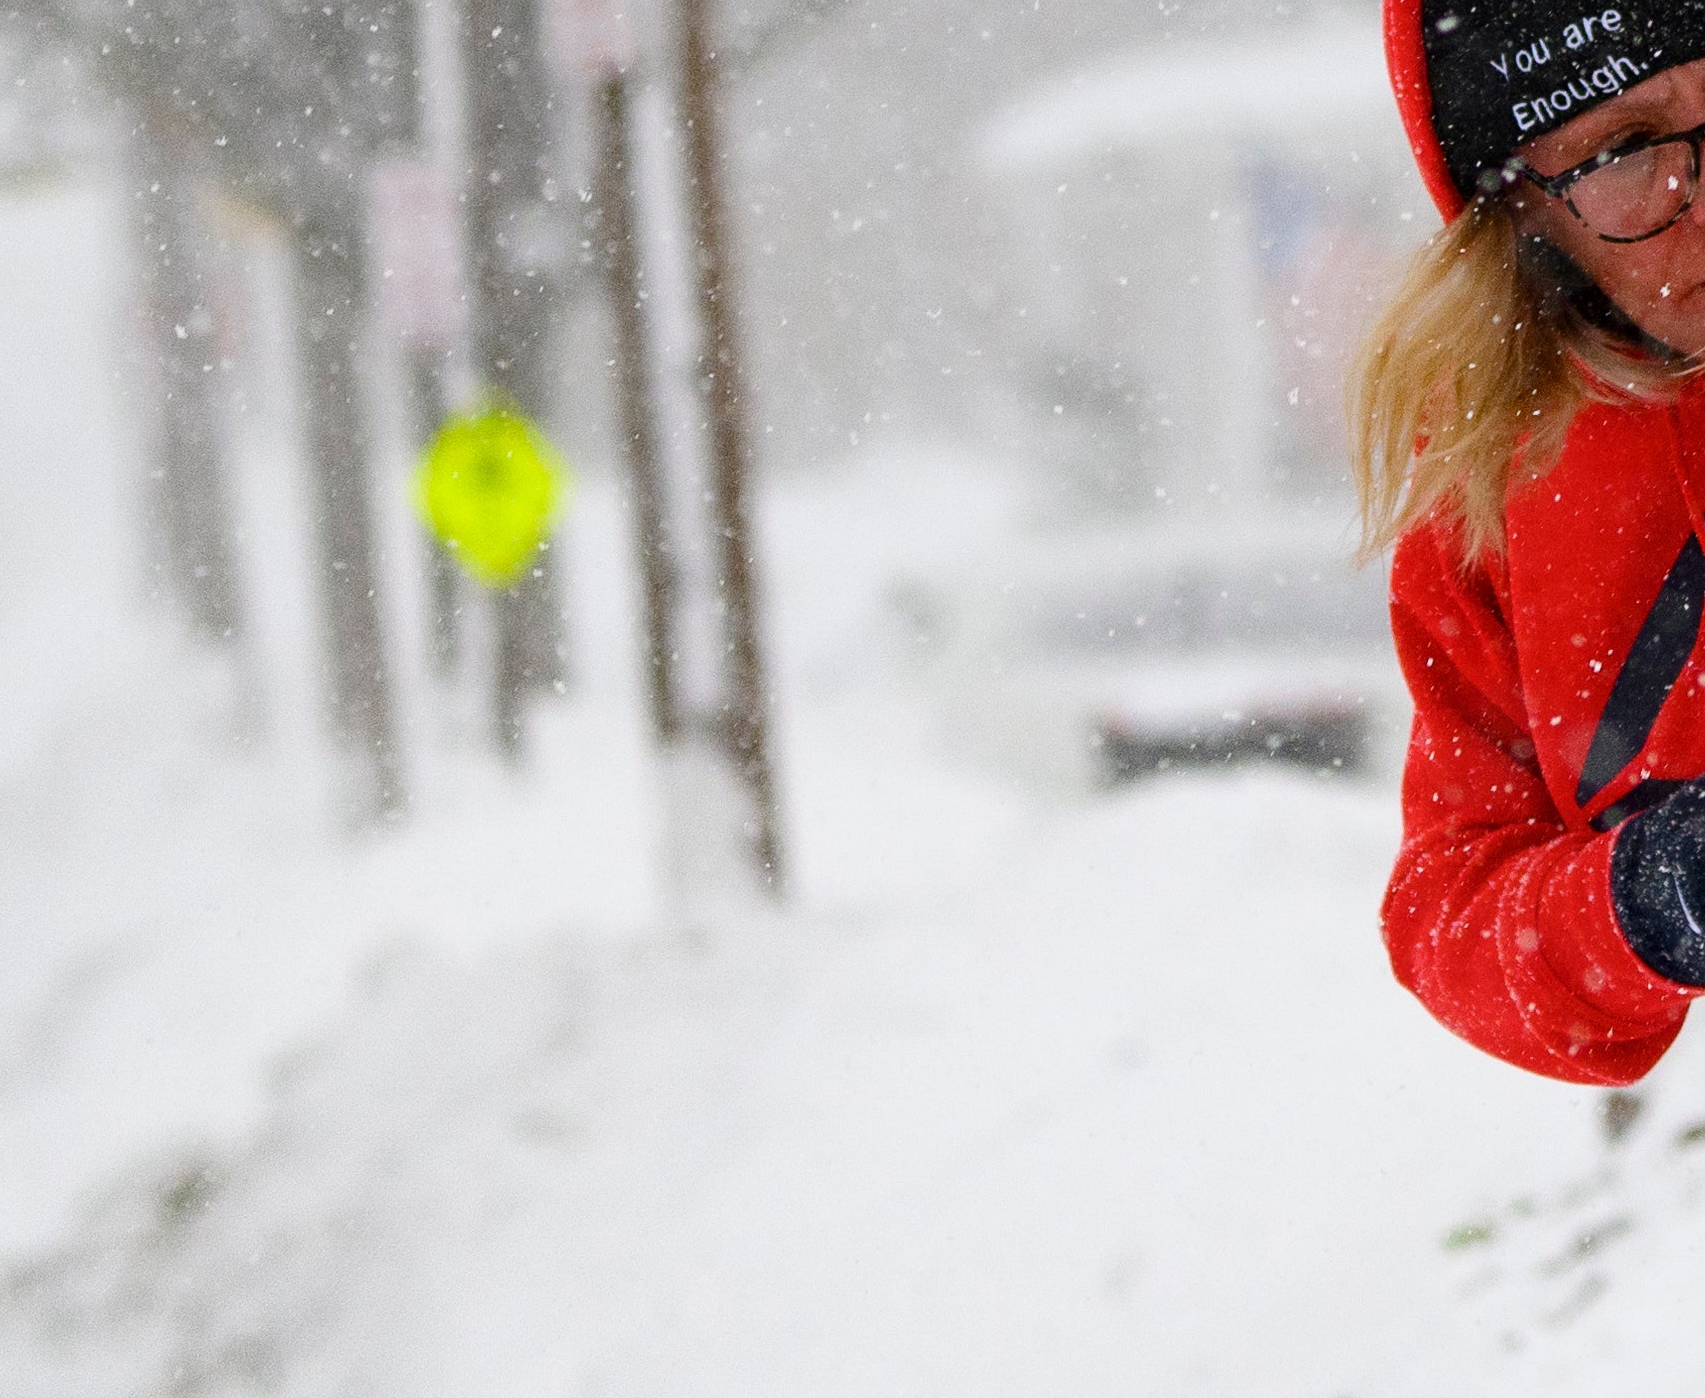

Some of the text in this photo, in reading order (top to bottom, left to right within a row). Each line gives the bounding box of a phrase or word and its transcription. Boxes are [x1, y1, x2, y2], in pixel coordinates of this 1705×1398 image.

[1490, 9, 1622, 82] You are
[1511, 55, 1648, 131] Enough.
